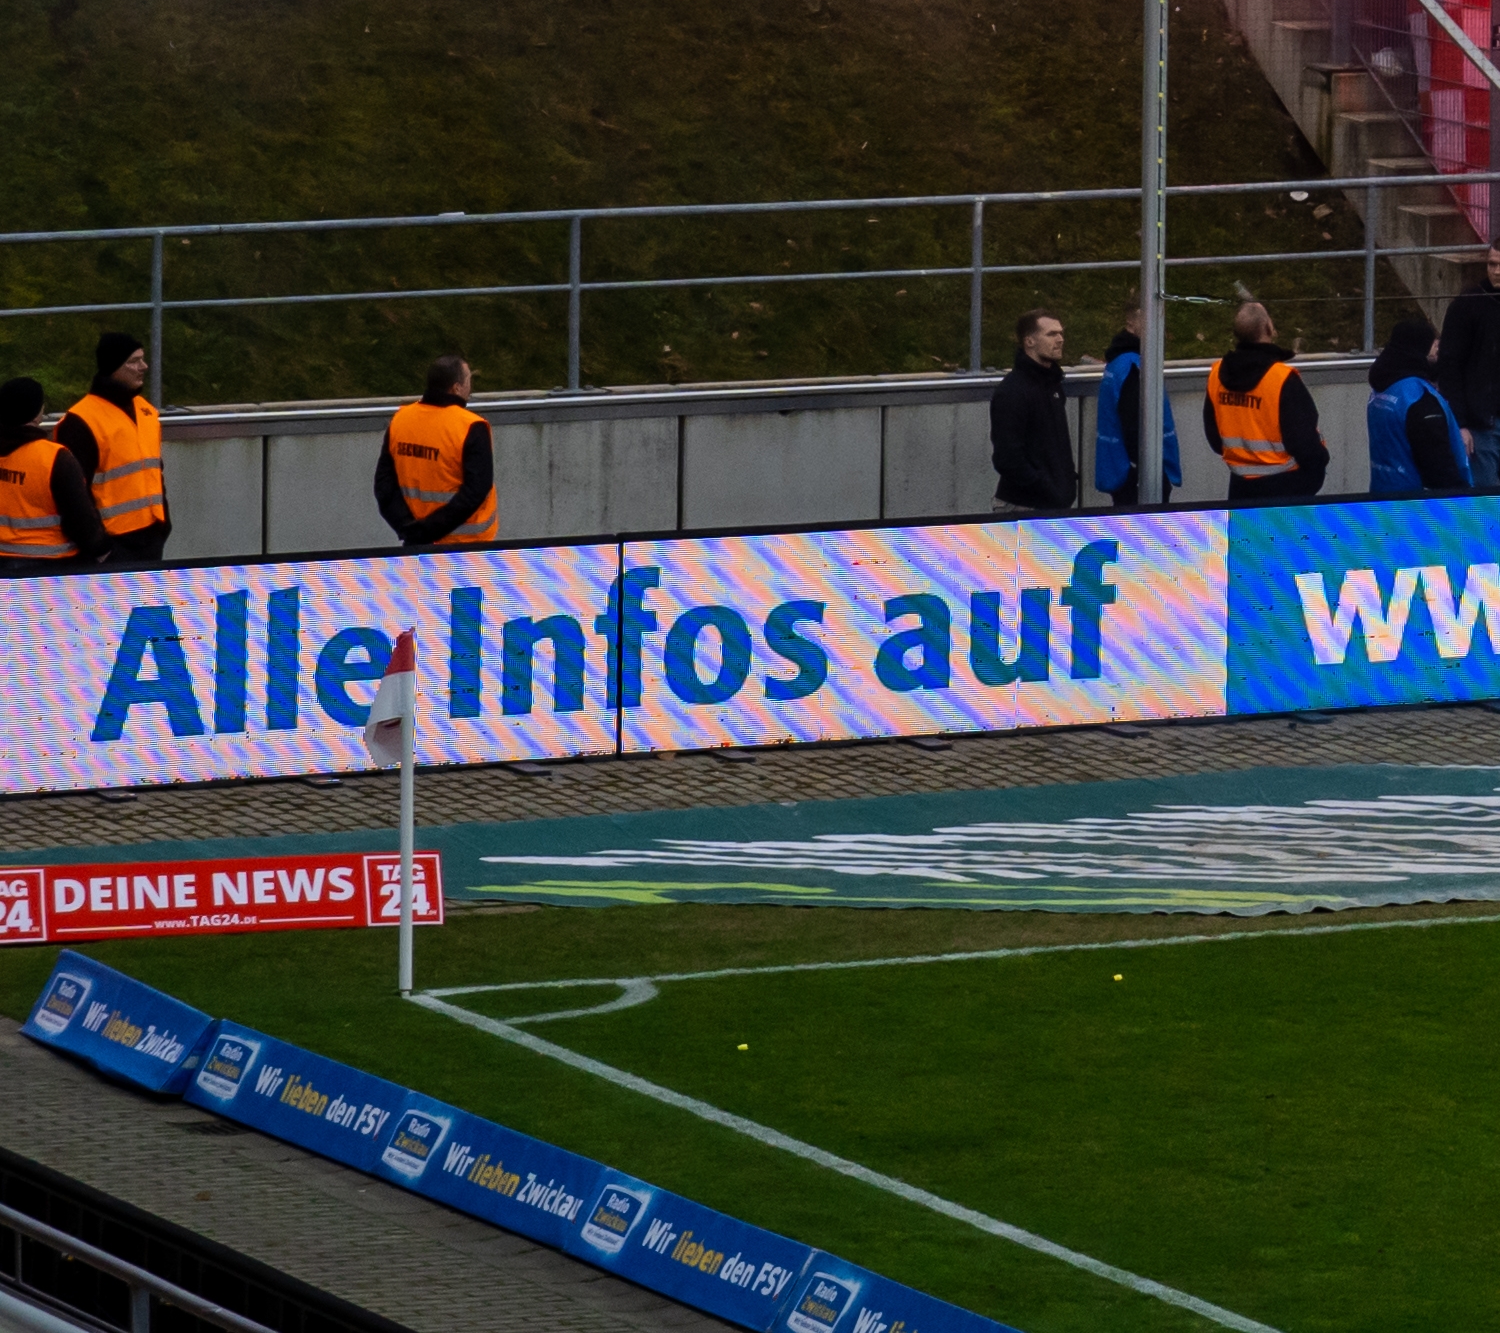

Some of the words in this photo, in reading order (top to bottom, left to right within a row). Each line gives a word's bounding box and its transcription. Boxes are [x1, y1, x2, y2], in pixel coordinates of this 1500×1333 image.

[1218, 390, 1263, 411] SECURITY
[397, 441, 440, 462] SECURITY
[90, 585, 402, 744] Alle
[449, 565, 826, 719] Infos
[873, 540, 1120, 694] auf
[54, 874, 198, 913] DEINE
[212, 866, 356, 907] NEWS
[377, 862, 426, 883] TAG
[379, 882, 431, 917] 24
[154, 914, 258, 929] www.TAG24.DE
[82, 1000, 110, 1033] Wir
[101, 1009, 143, 1048] lieben
[134, 1024, 186, 1064] Zwickau
[254, 1064, 284, 1098] Wir
[279, 1073, 330, 1117] lieben
[325, 1093, 358, 1129] den
[352, 1103, 391, 1139] FSV
[442, 1141, 476, 1178] Wir
[467, 1153, 521, 1198] lieben
[515, 1172, 584, 1221] Zwickau
[606, 1192, 631, 1214] Radio
[641, 1217, 678, 1255] Wir
[670, 1230, 725, 1276] lieben
[719, 1251, 756, 1289] den
[751, 1261, 793, 1299] FSV
